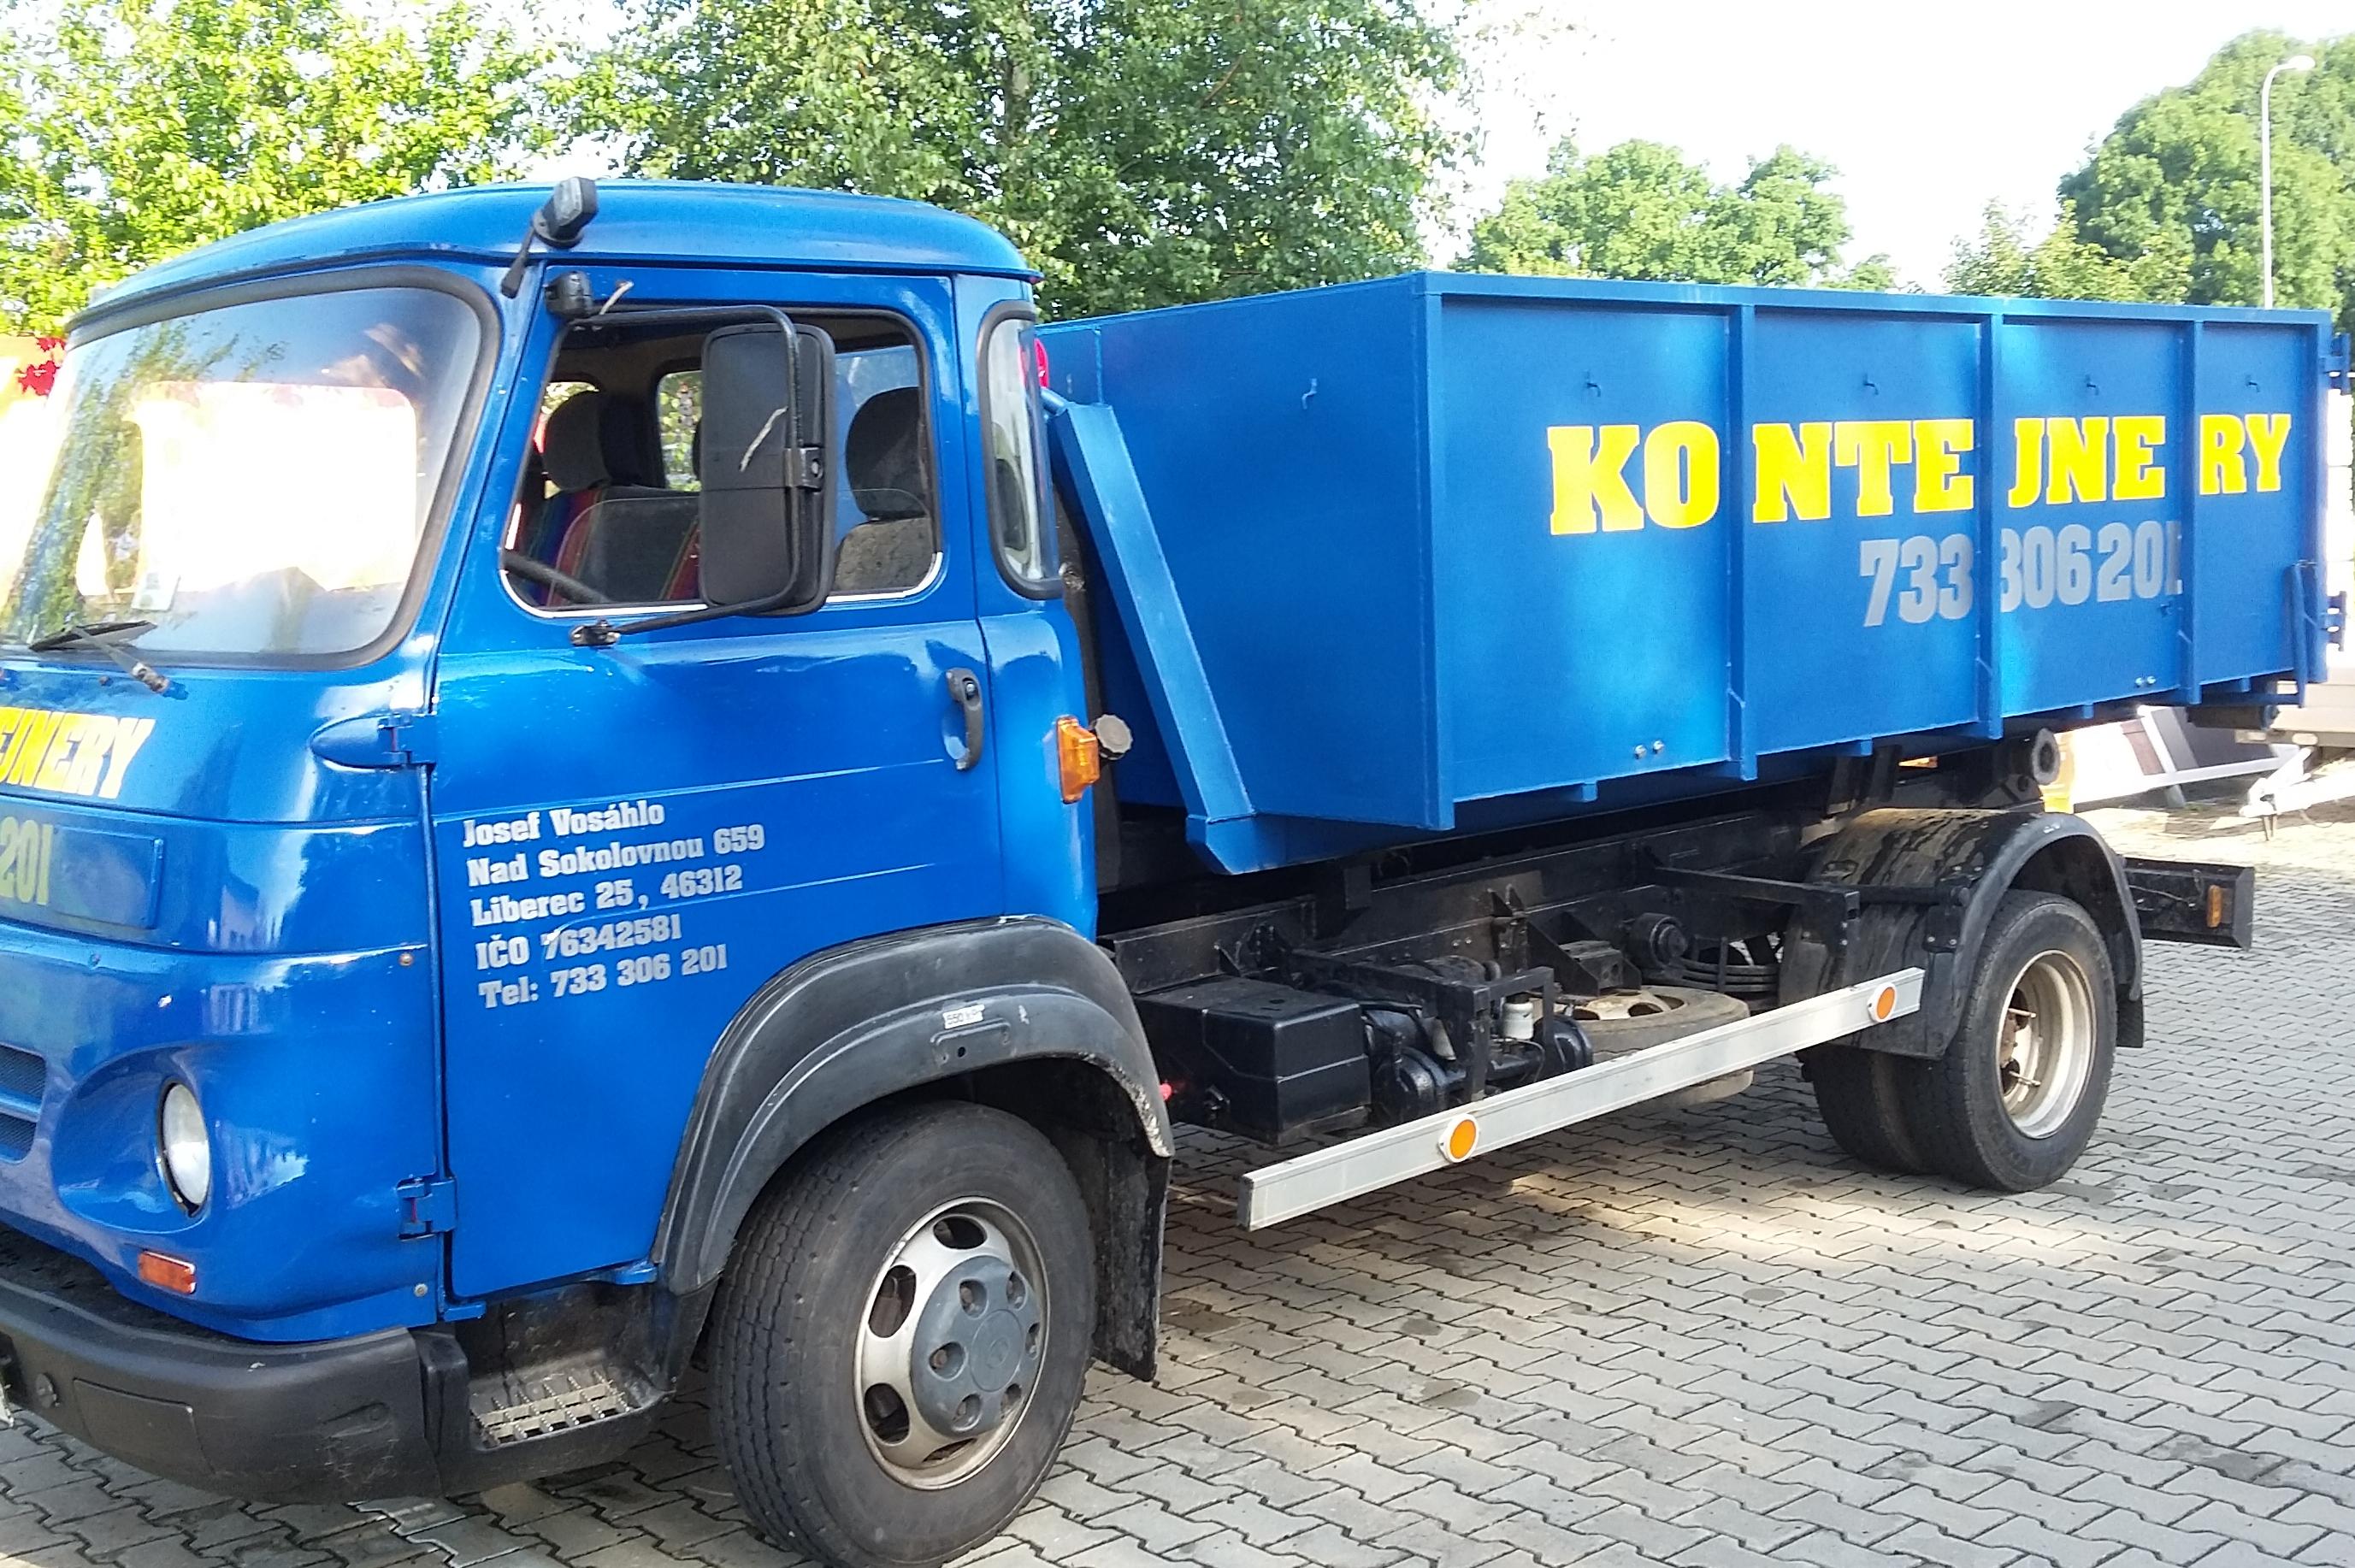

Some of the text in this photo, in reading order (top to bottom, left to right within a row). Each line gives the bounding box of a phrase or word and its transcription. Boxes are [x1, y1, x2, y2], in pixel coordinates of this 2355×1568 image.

[1859, 533, 1974, 628] 733
[463, 799, 665, 847] Josef Vosáhlo
[466, 824, 764, 887] Nad Sokolovnou 659
[470, 892, 586, 927] Liberec
[660, 864, 743, 899] 46312
[475, 913, 682, 970] IČO 76342581
[478, 943, 729, 1009] Tel: 733 306 201
